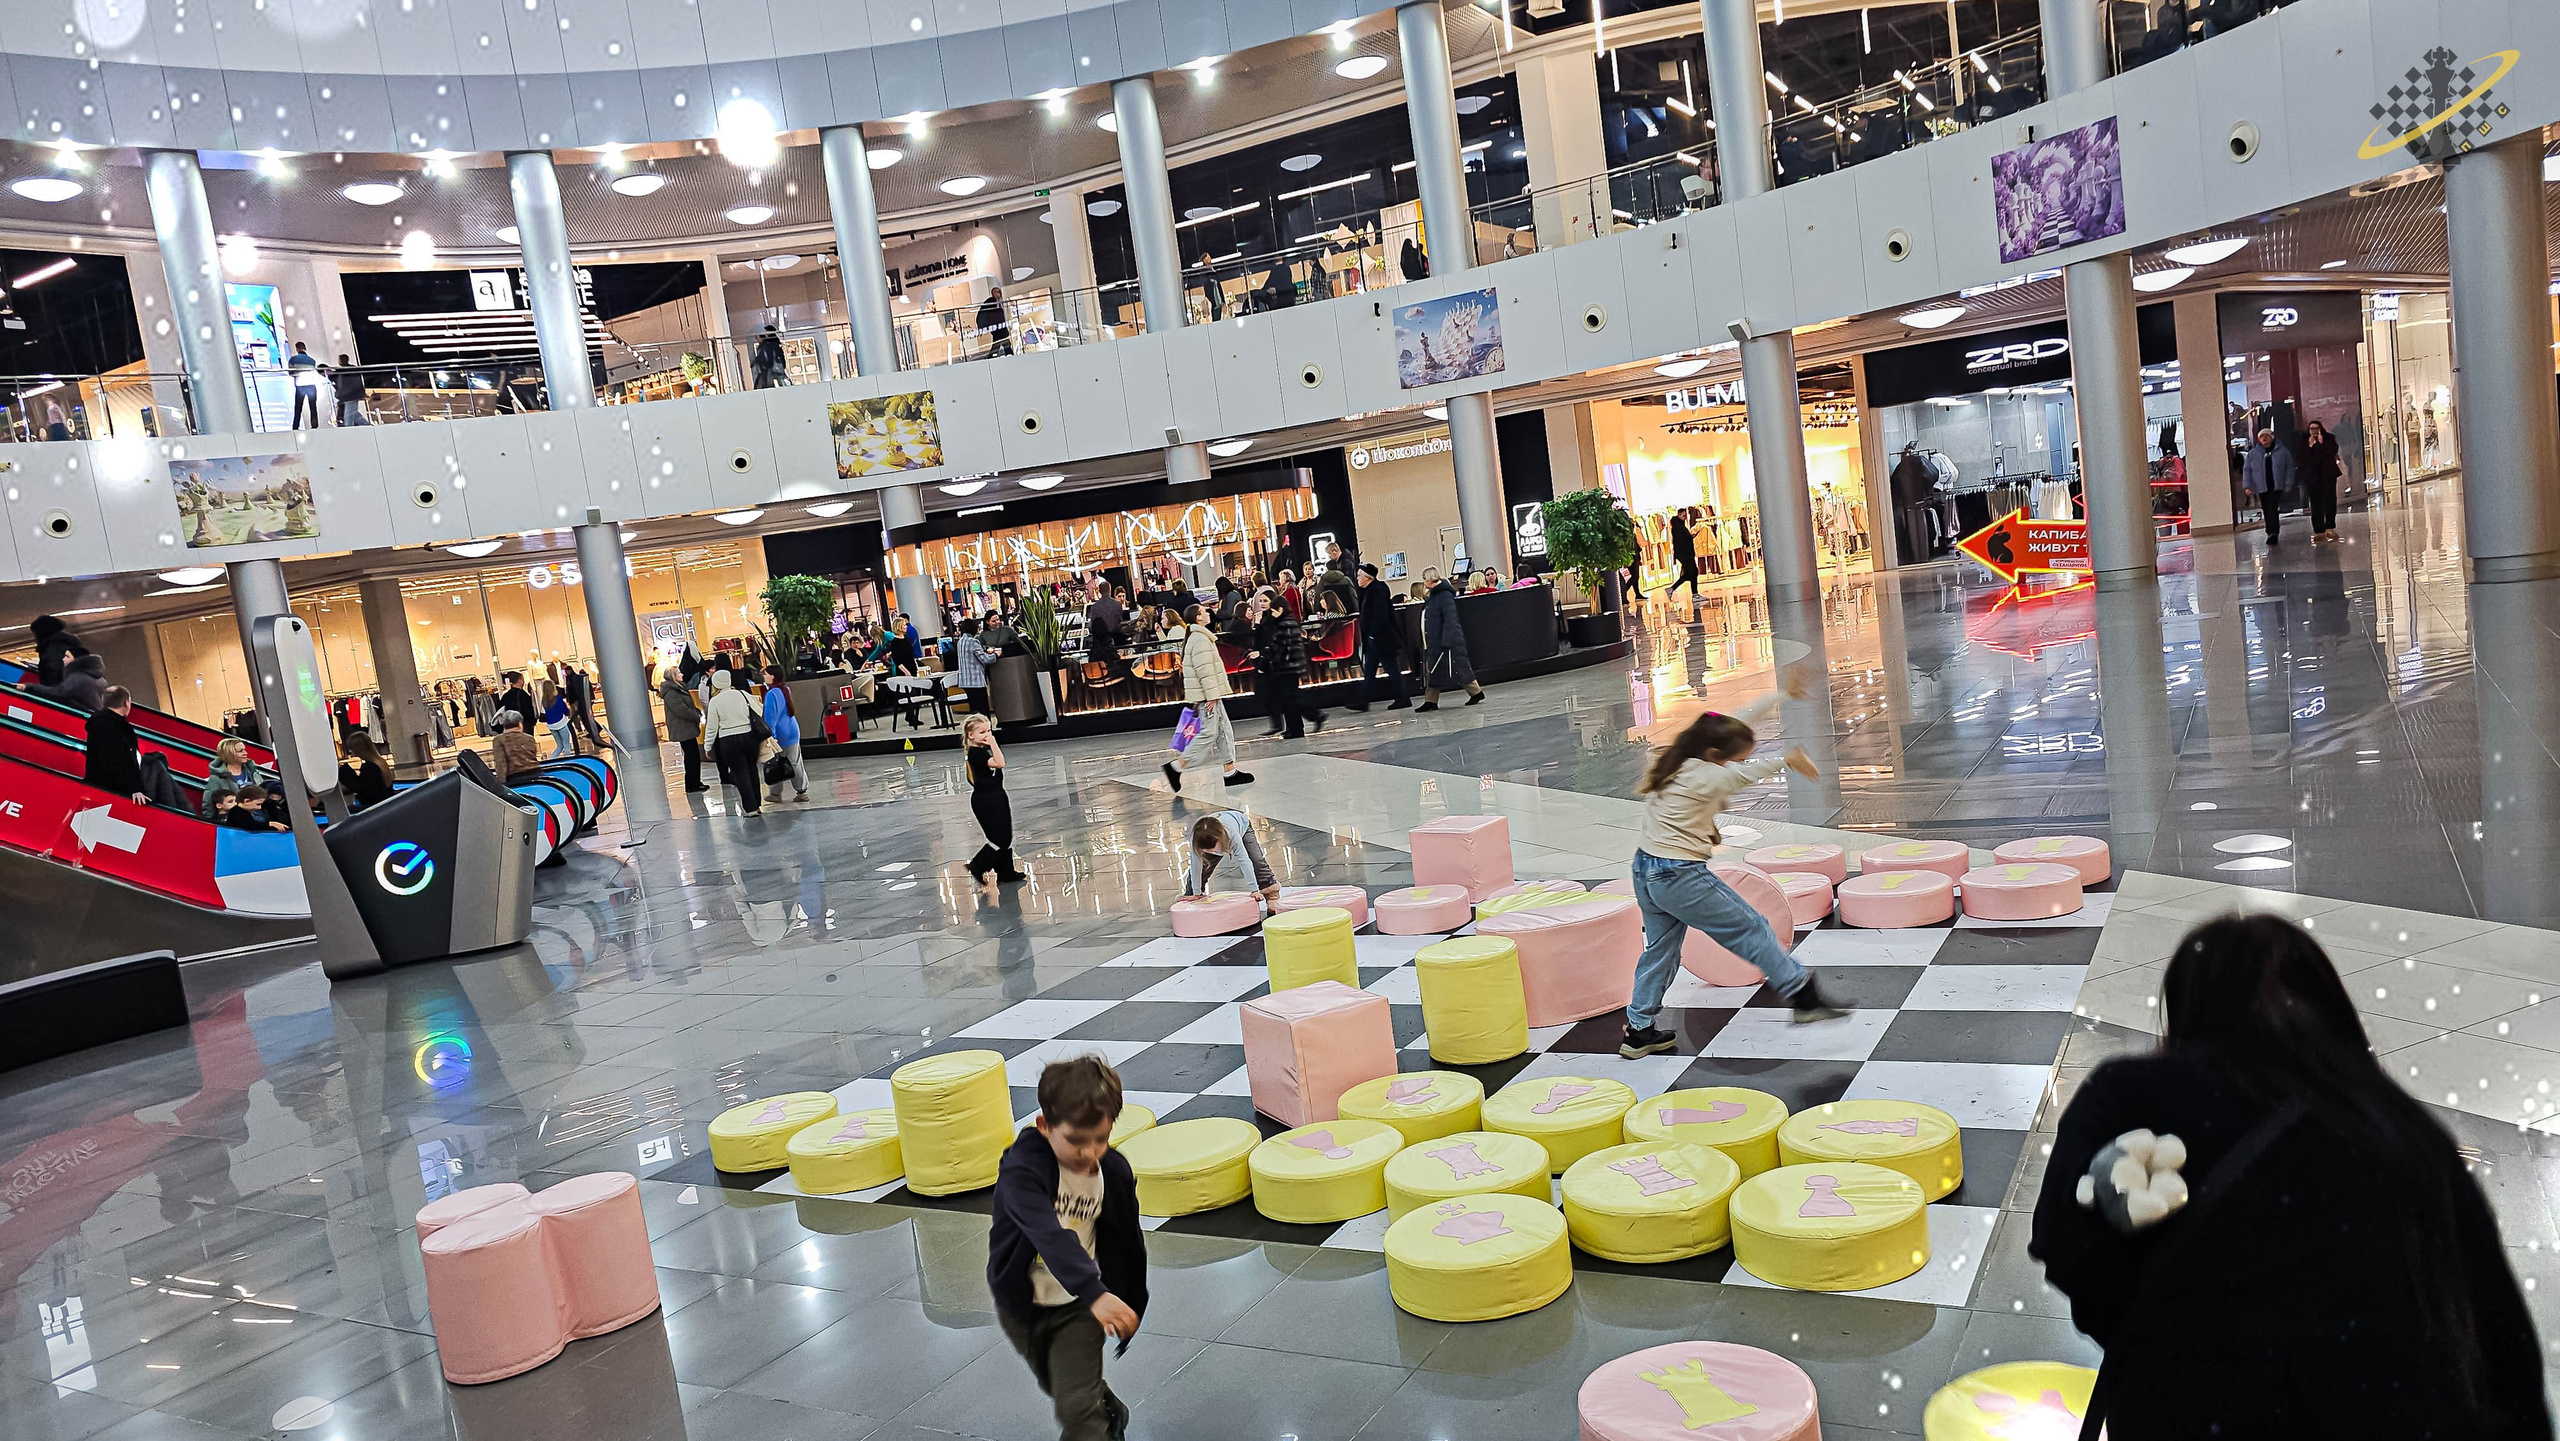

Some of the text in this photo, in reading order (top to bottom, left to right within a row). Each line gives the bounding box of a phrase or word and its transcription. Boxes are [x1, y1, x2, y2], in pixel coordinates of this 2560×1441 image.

[2262, 307, 2298, 327] ZRD
[1965, 338, 2069, 370] ZRD
[1968, 358, 2038, 375] conceptual brand
[2028, 543, 2080, 553] ЖИВУТ
